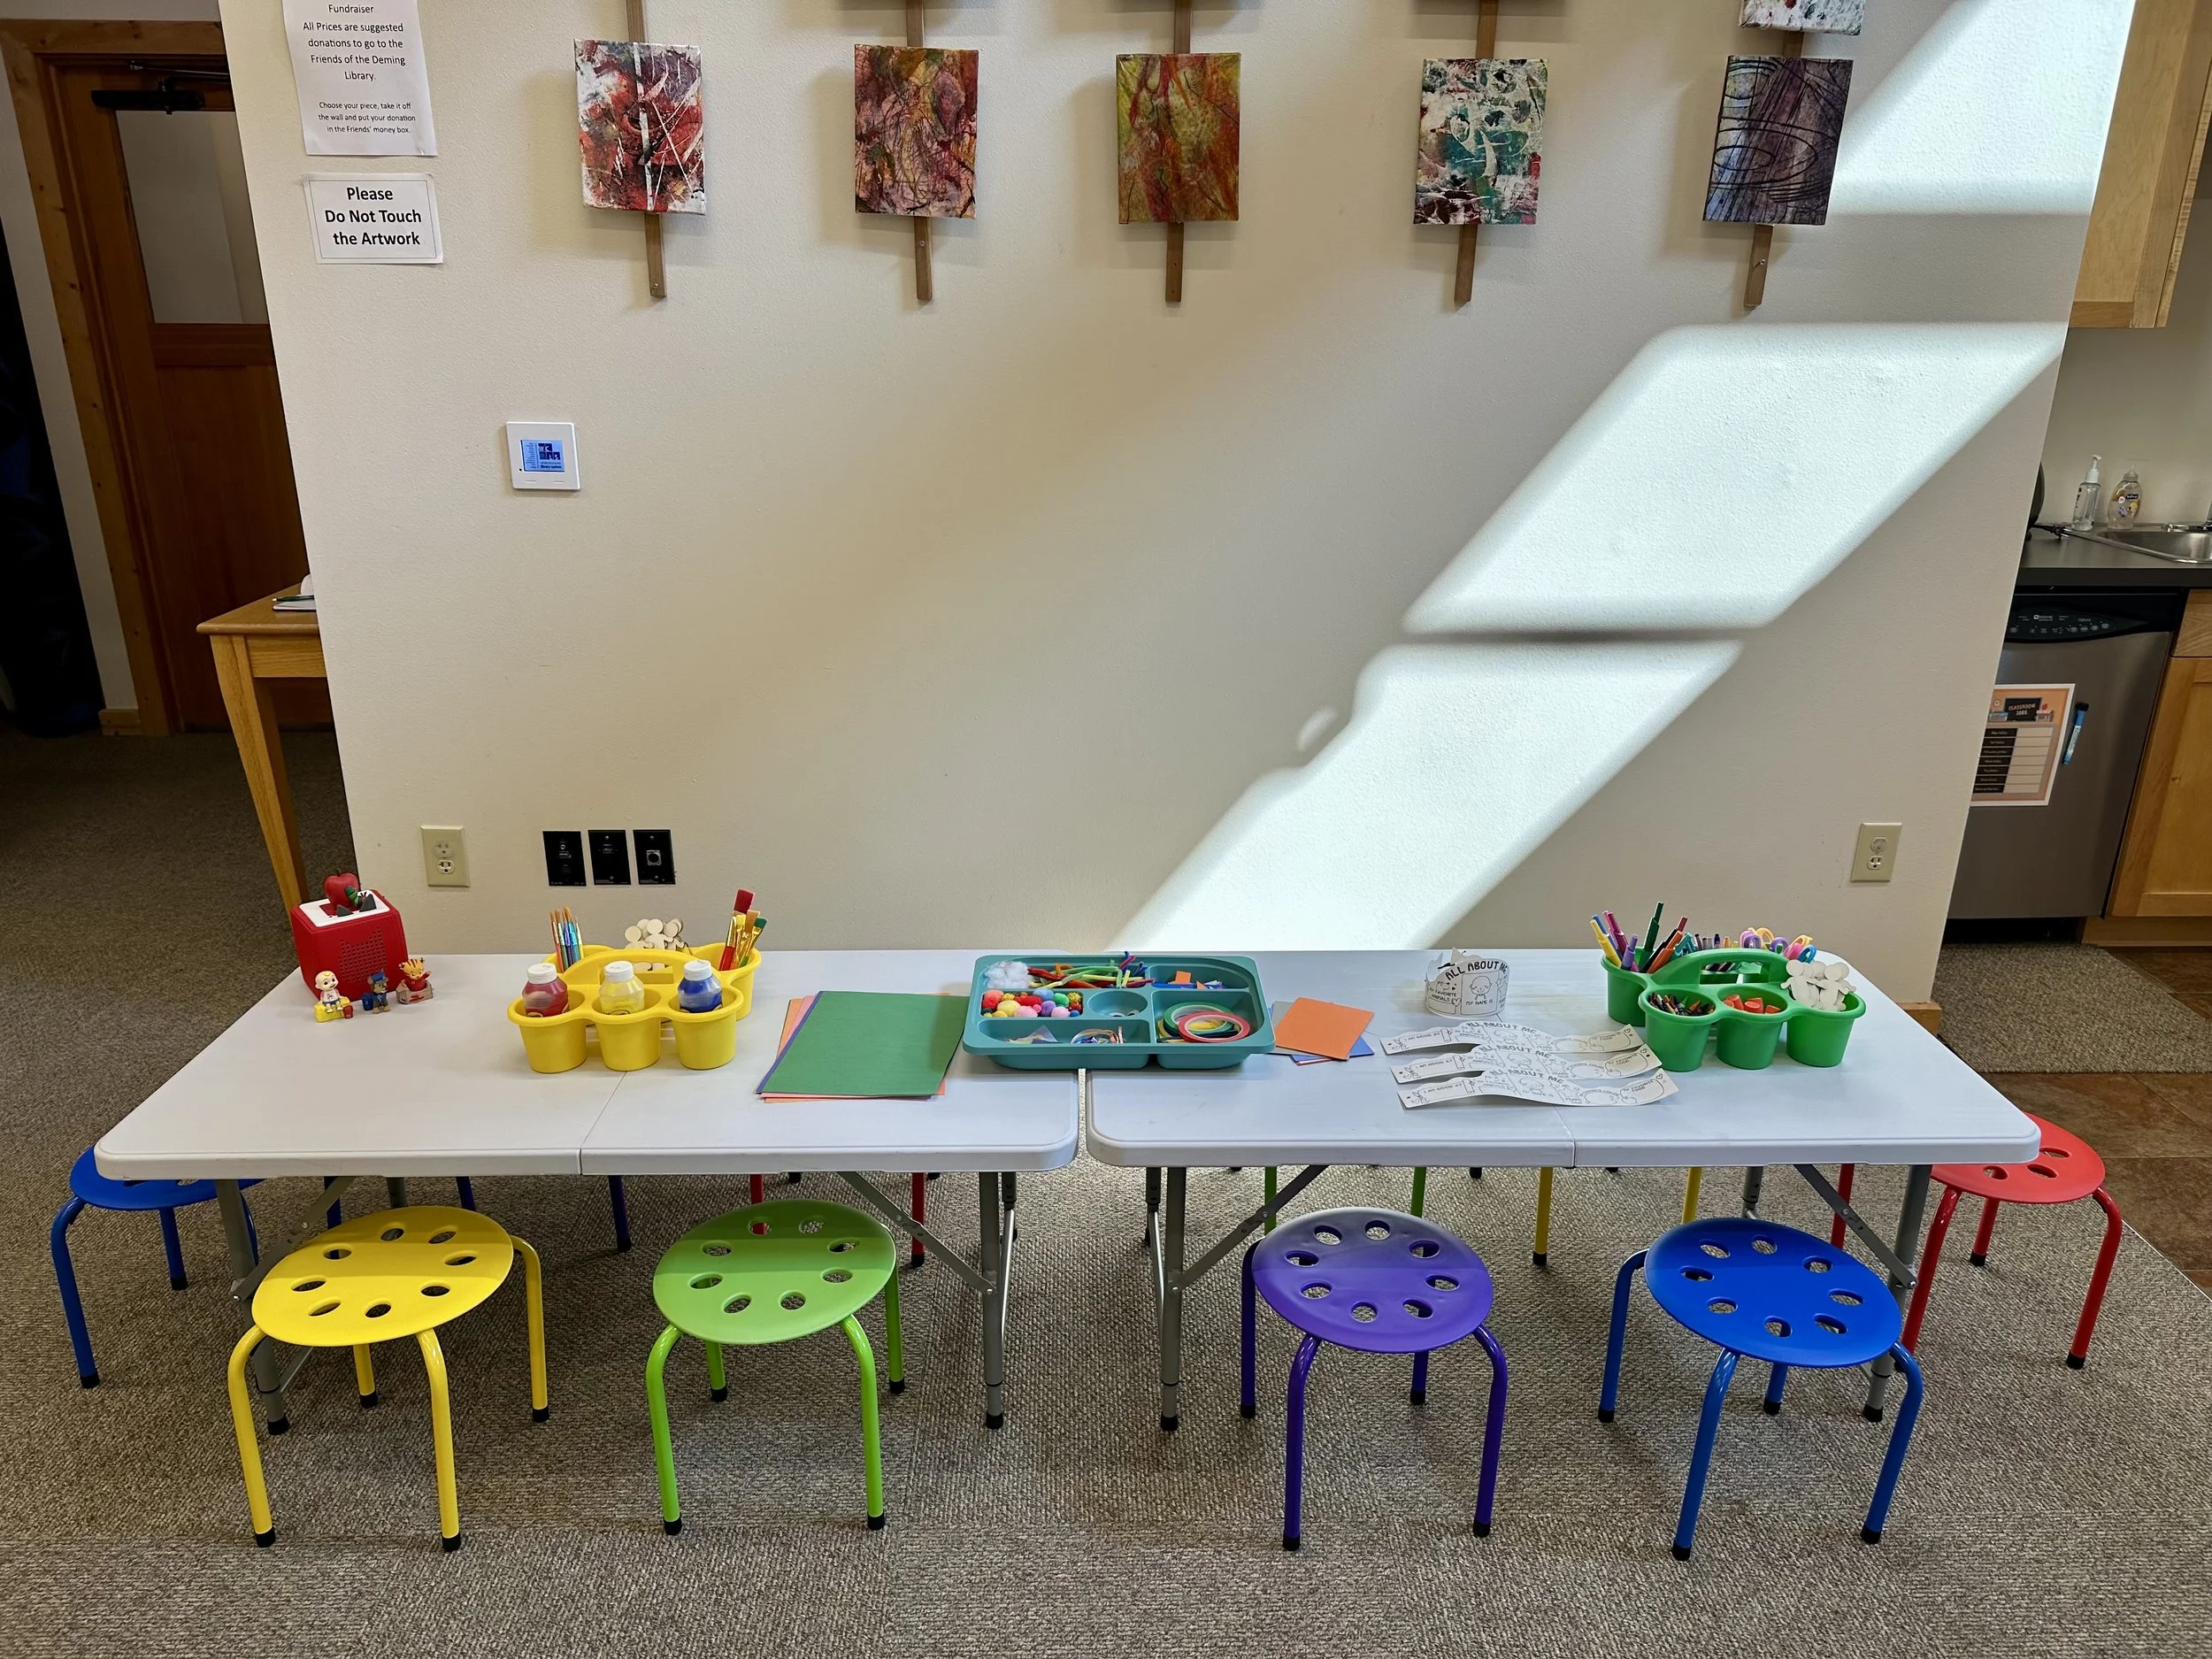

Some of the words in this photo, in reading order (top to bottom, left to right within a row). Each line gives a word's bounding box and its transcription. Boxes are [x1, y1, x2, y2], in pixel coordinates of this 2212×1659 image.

[361, 23, 403, 33] suggested
[356, 55, 369, 64] the
[373, 56, 405, 65] Deming
[345, 72, 375, 81] Library.
[347, 187, 393, 200] Please
[325, 211, 345, 222] Do
[349, 210, 376, 222] Not
[379, 210, 421, 222] Touch
[333, 232, 357, 244] the
[362, 232, 420, 244] Artwork
[1445, 966, 1465, 980] ALL
[1468, 961, 1499, 972] ABOUT
[1499, 963, 1508, 974] ME
[1508, 1069, 1544, 1078] ABOUT
